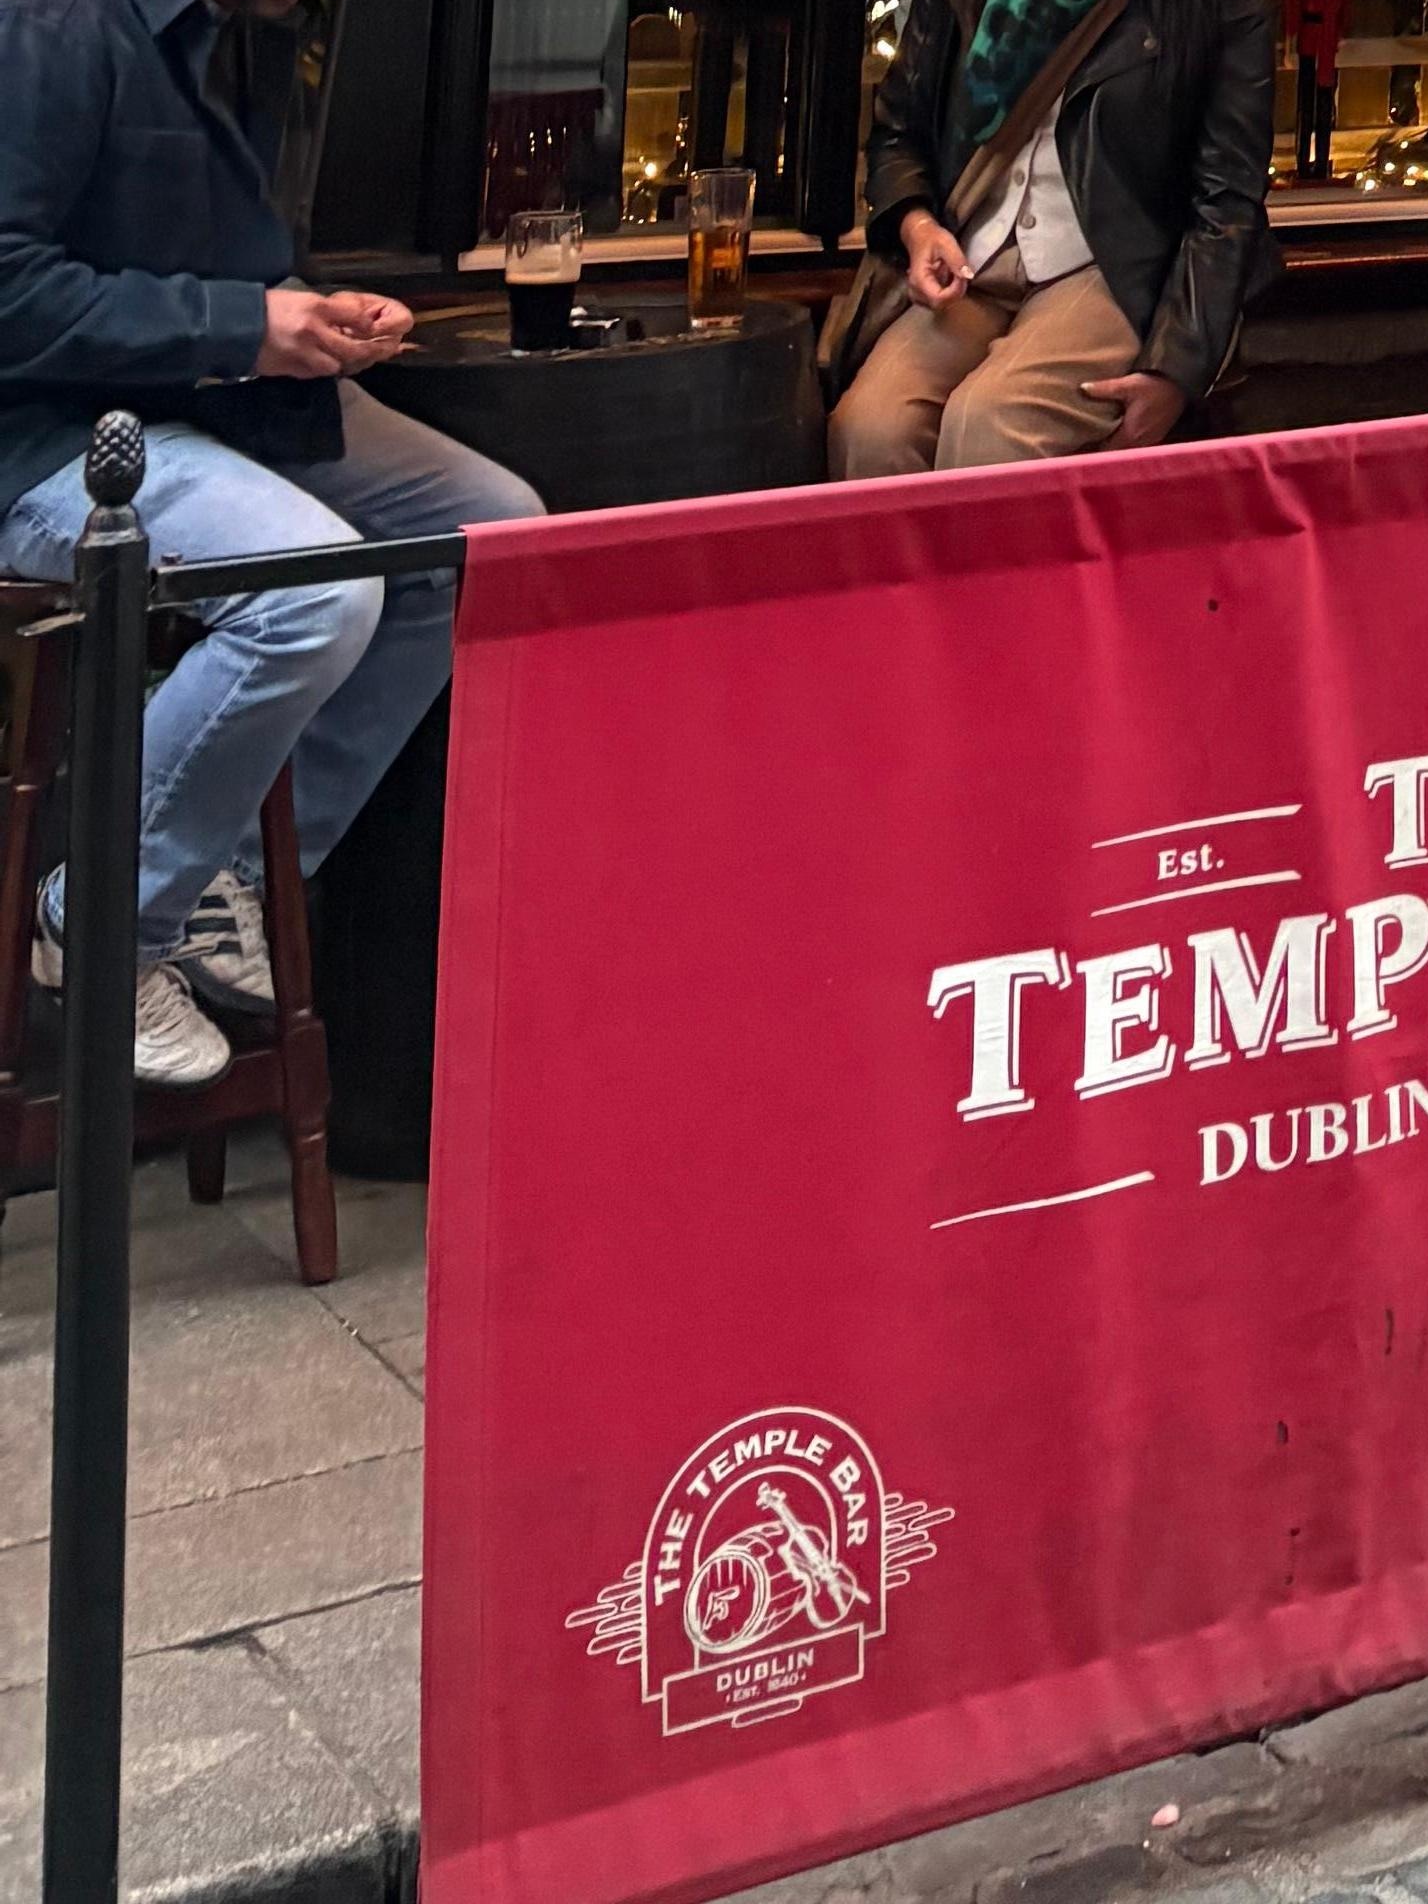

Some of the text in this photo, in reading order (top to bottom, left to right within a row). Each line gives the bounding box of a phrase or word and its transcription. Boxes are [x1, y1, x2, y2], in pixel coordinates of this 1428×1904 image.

[1158, 844, 1224, 880] Est.
[654, 1429, 869, 1606] THE TEMPLE BAR
[716, 1649, 814, 1692] DUBLIN
